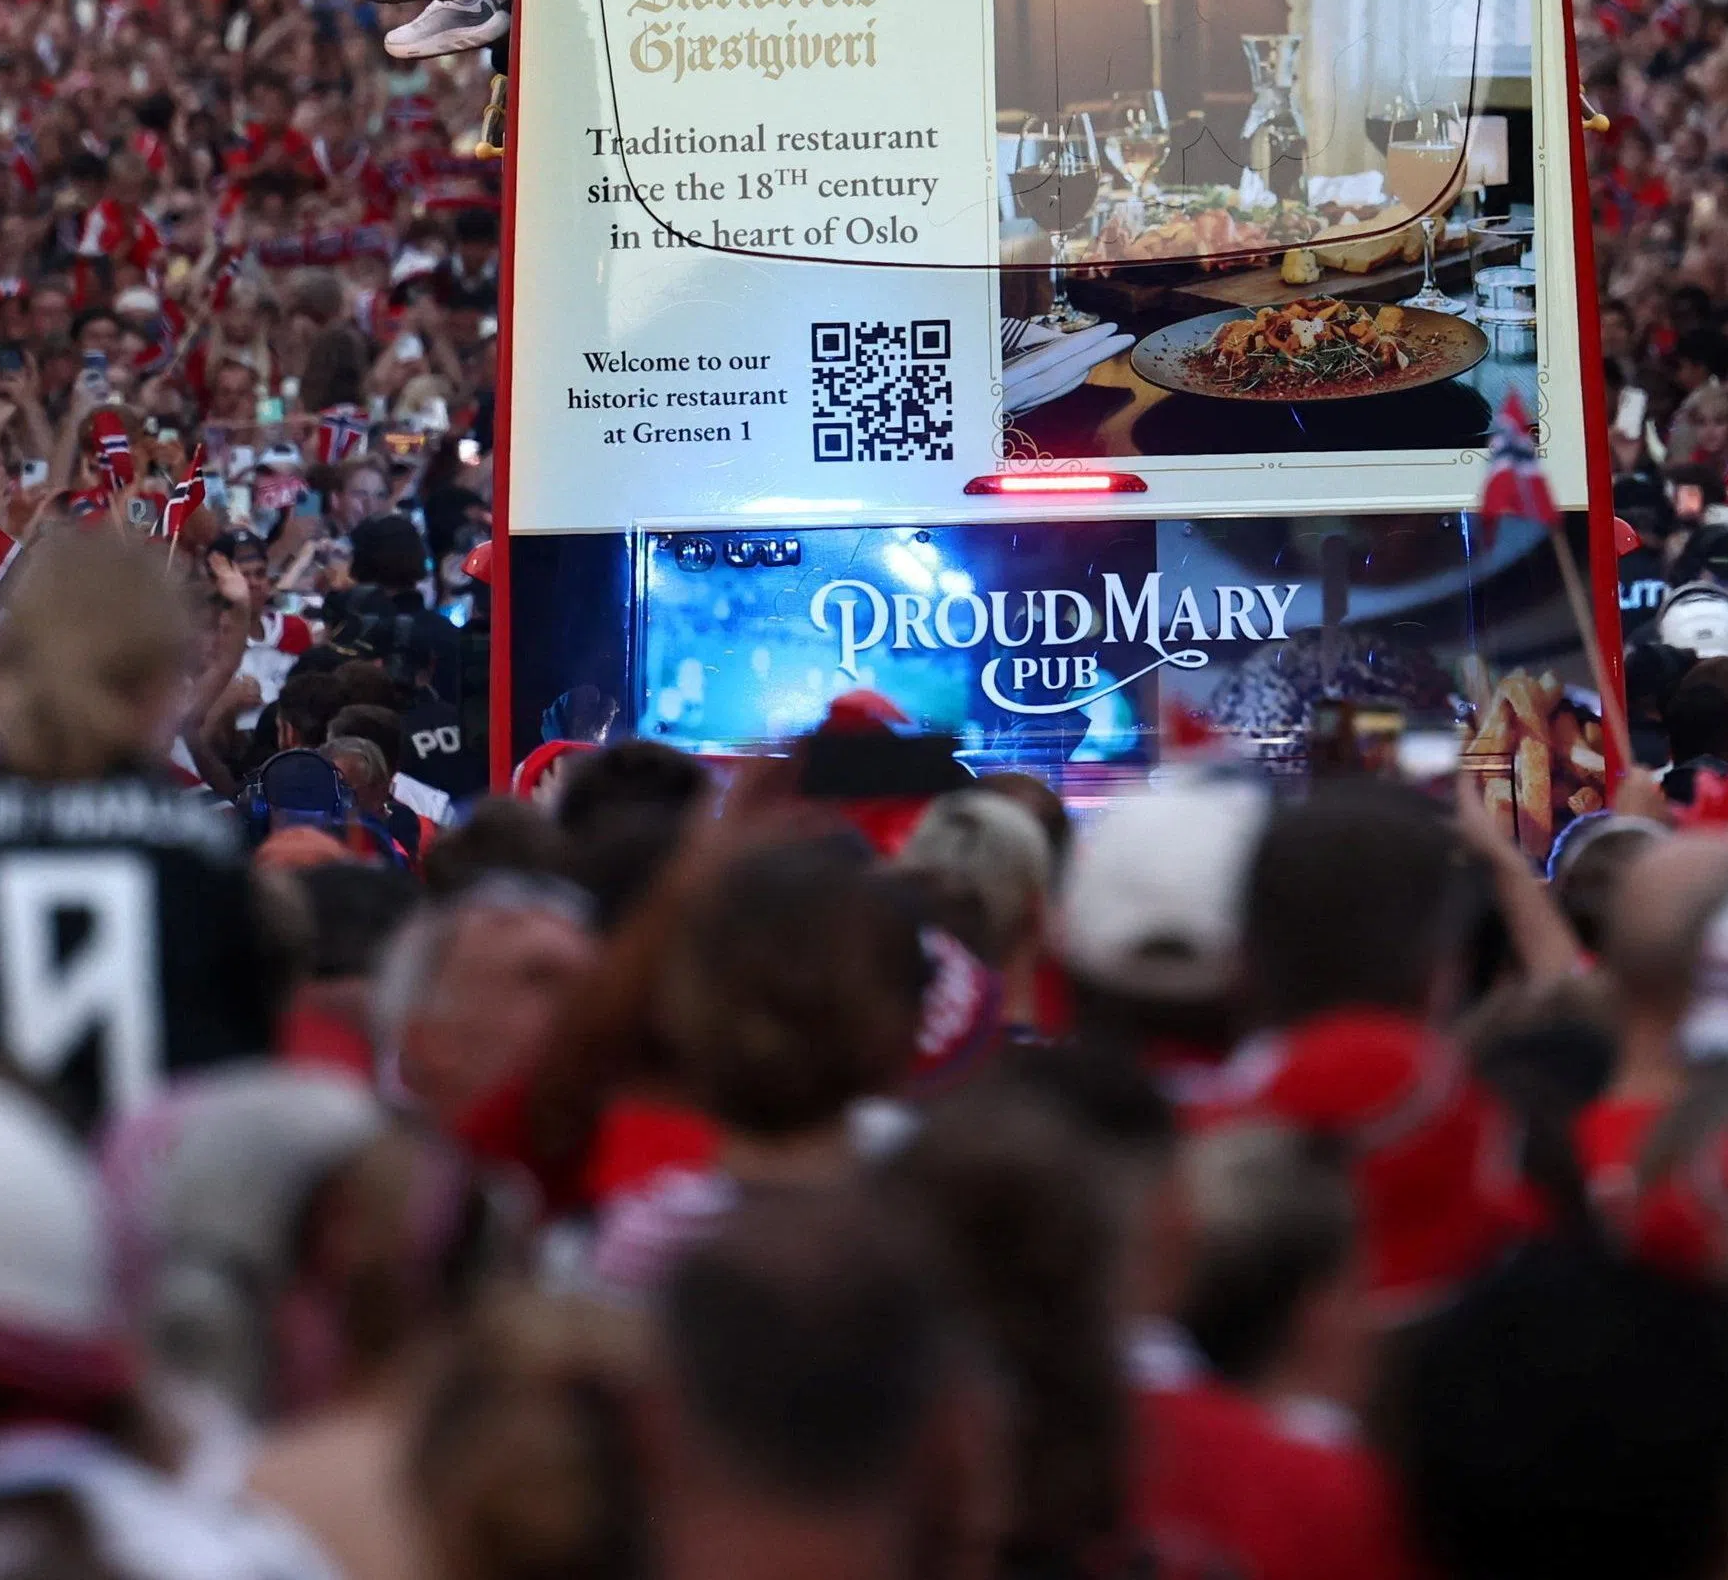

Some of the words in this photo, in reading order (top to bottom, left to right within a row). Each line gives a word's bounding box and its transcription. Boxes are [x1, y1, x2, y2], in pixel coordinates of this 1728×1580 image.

[629, 18, 877, 83] Gjæstgiveri
[586, 124, 767, 155] Traditional
[776, 125, 939, 151] restaurant
[588, 176, 665, 203] since
[675, 172, 725, 200] the
[818, 177, 940, 205] century
[610, 224, 641, 249] in
[652, 220, 702, 248] the
[712, 219, 795, 249] heart
[804, 216, 840, 246] of
[846, 216, 919, 245] Oslo
[583, 351, 690, 373] Welcome
[698, 354, 722, 371] to
[729, 355, 771, 370] our
[568, 388, 659, 409] historic
[666, 387, 789, 407] restaurant
[604, 428, 626, 444] at
[633, 422, 731, 443] Grensen
[740, 421, 752, 441] 1
[810, 579, 1094, 680] PROUD
[1102, 572, 1304, 648] MARY
[1013, 657, 1100, 690] PUB
